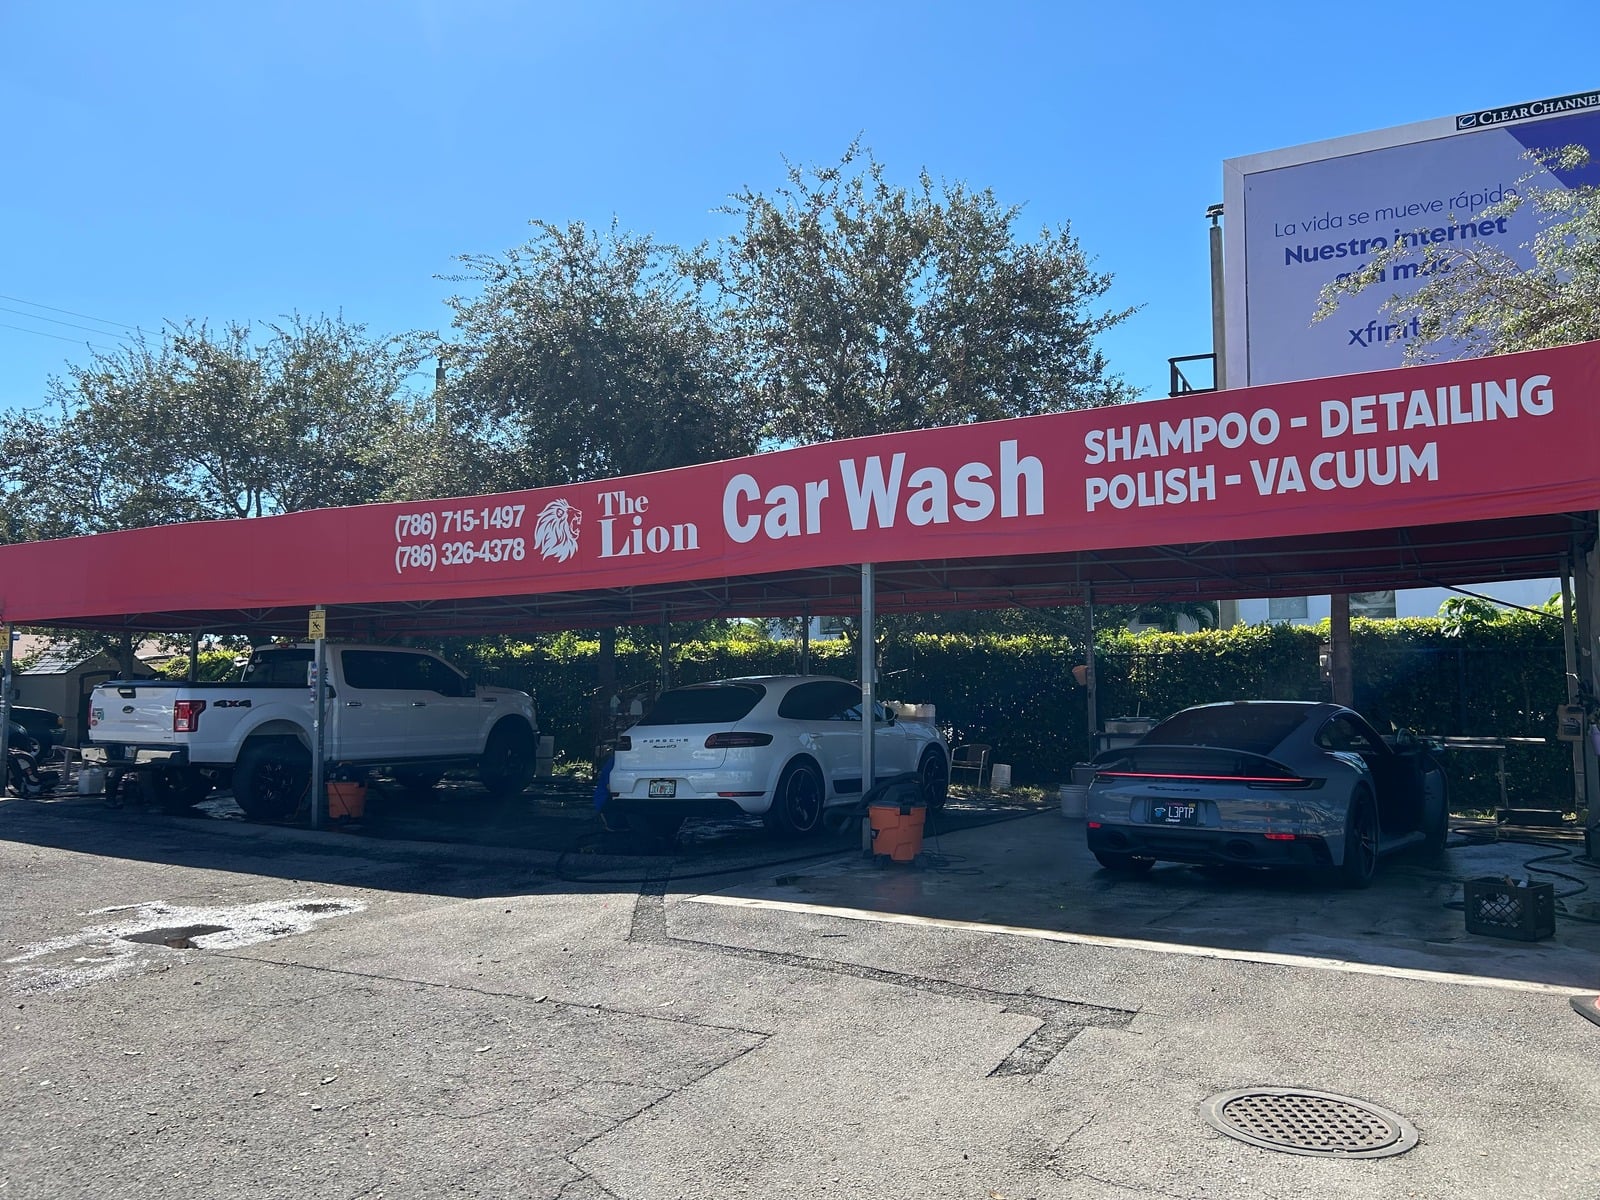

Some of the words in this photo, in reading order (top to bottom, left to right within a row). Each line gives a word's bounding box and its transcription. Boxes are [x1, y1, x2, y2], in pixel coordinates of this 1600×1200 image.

[1275, 223, 1296, 238] La
[1301, 211, 1343, 233] vida
[1348, 212, 1370, 226] se
[1375, 199, 1443, 222] mueve
[1285, 236, 1388, 266] Nuestro
[1084, 407, 1281, 466] SHAMPOO
[1320, 374, 1554, 439] DETAILING
[722, 473, 830, 545] Car
[839, 439, 1046, 532] Wash
[1085, 464, 1217, 513] POLISH
[1249, 442, 1439, 497] VACUUM
[597, 490, 649, 517] The
[395, 511, 437, 543] (786)
[441, 504, 525, 533] 715-1497
[597, 515, 701, 559] Lion
[395, 543, 437, 574] (786)
[441, 537, 525, 566] 326-4378
